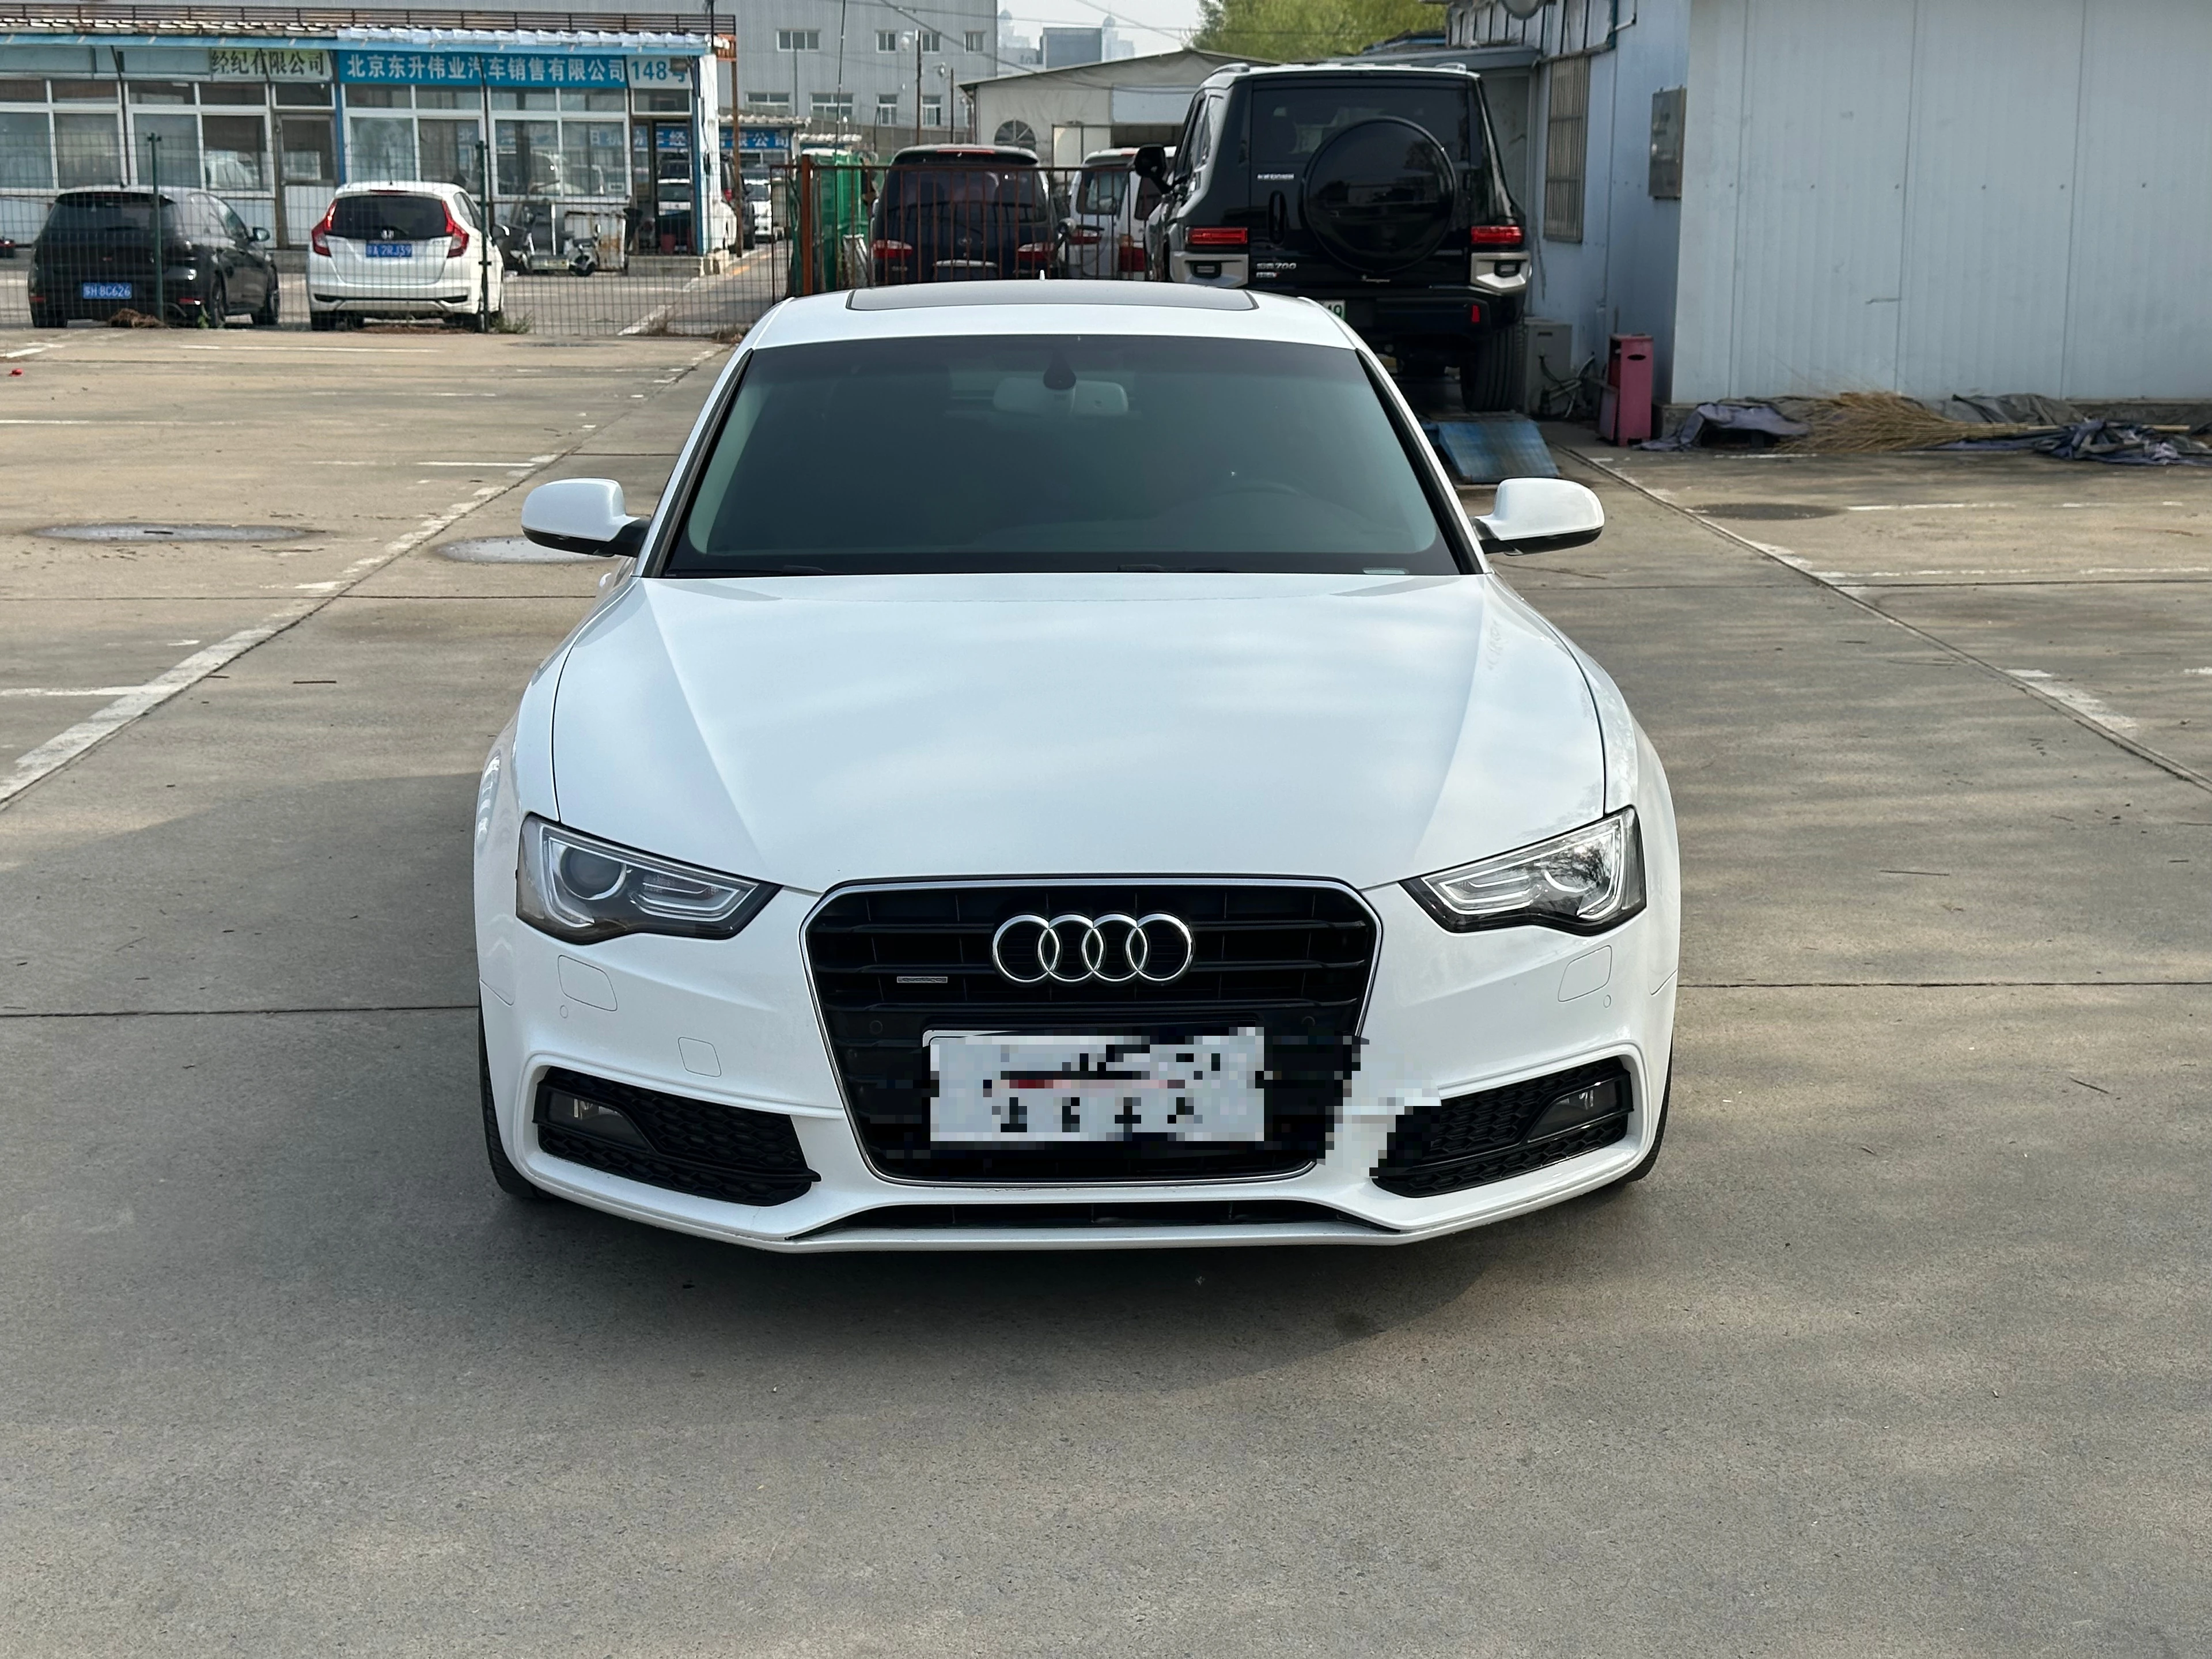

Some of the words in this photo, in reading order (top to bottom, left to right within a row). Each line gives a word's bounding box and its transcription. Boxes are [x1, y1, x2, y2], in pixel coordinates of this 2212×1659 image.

[211, 50, 324, 75] 经纪有限公司
[347, 54, 624, 82] 北京东升伟业汽车销售有限公司
